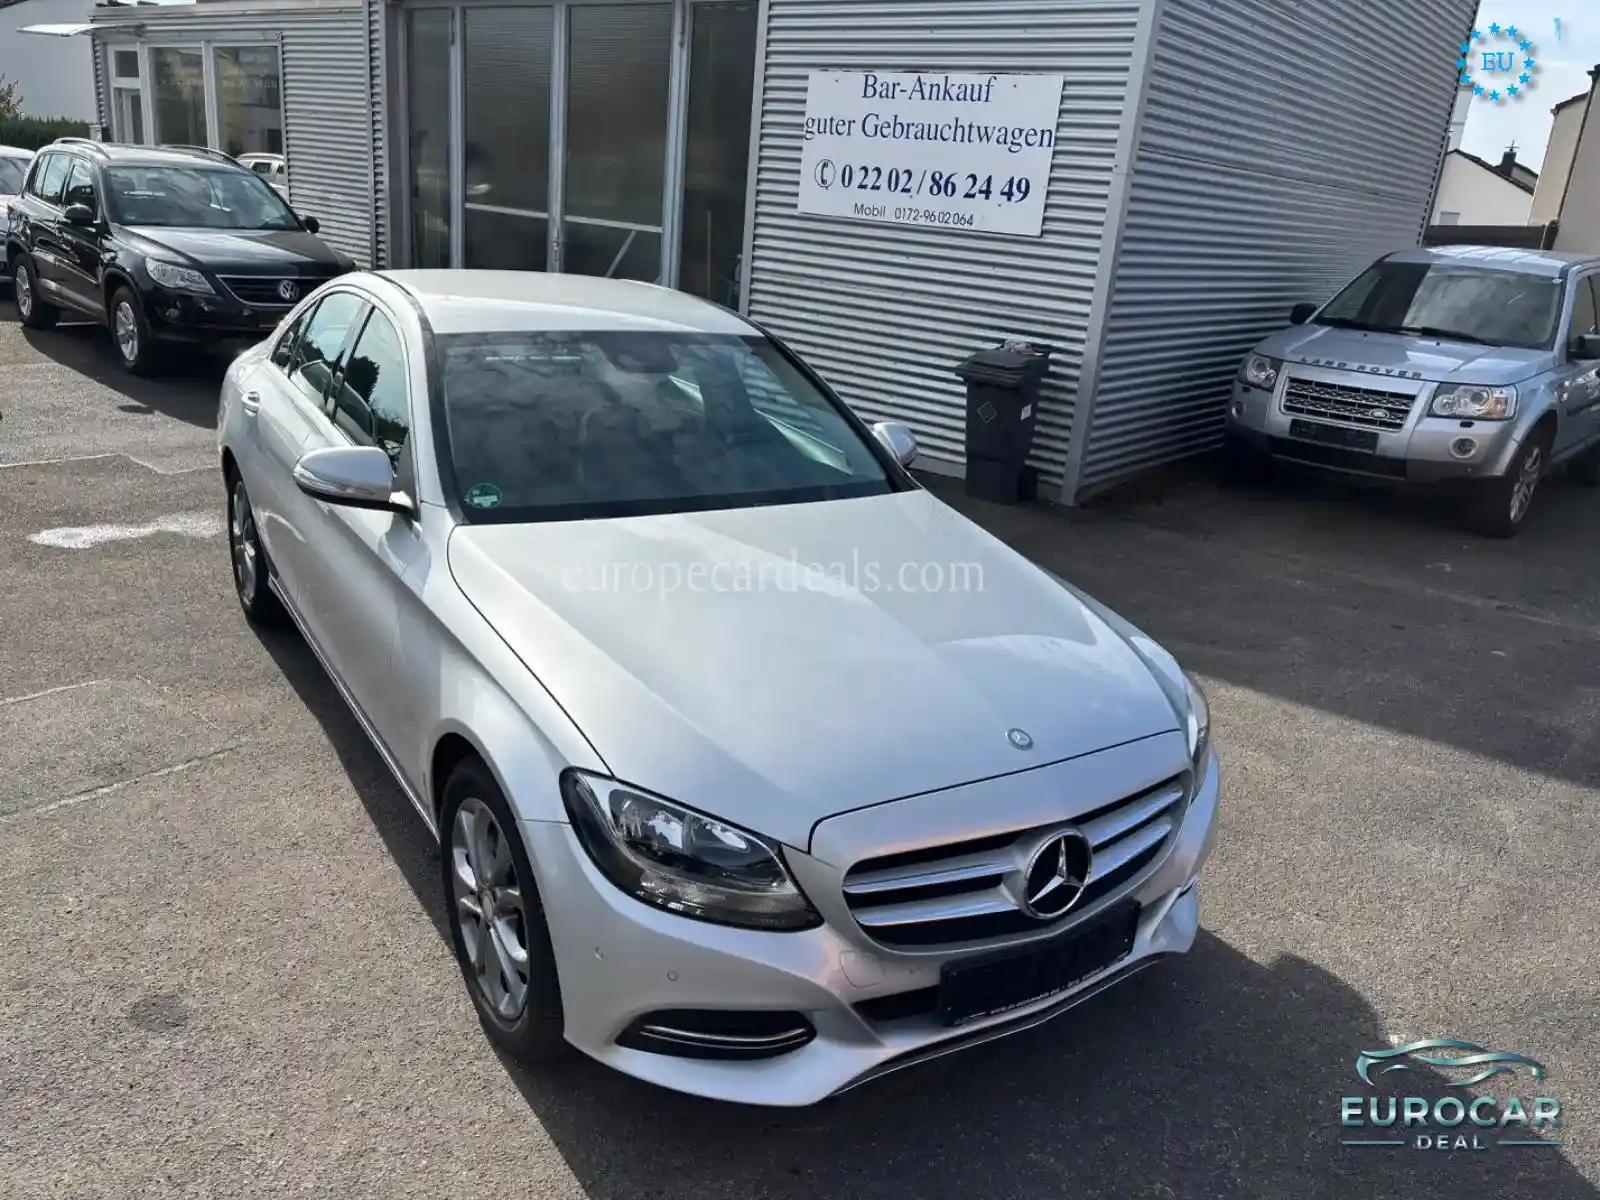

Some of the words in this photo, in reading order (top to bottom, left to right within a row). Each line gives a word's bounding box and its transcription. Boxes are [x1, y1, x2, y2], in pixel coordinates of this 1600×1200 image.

[862, 74, 997, 102] Bar-Ankauf
[803, 115, 856, 141] guter
[861, 113, 1053, 153] Gebrauchtwagen
[853, 202, 887, 218] Mobil
[1301, 358, 1347, 368] LAND
[1357, 365, 1422, 379] ROVER
